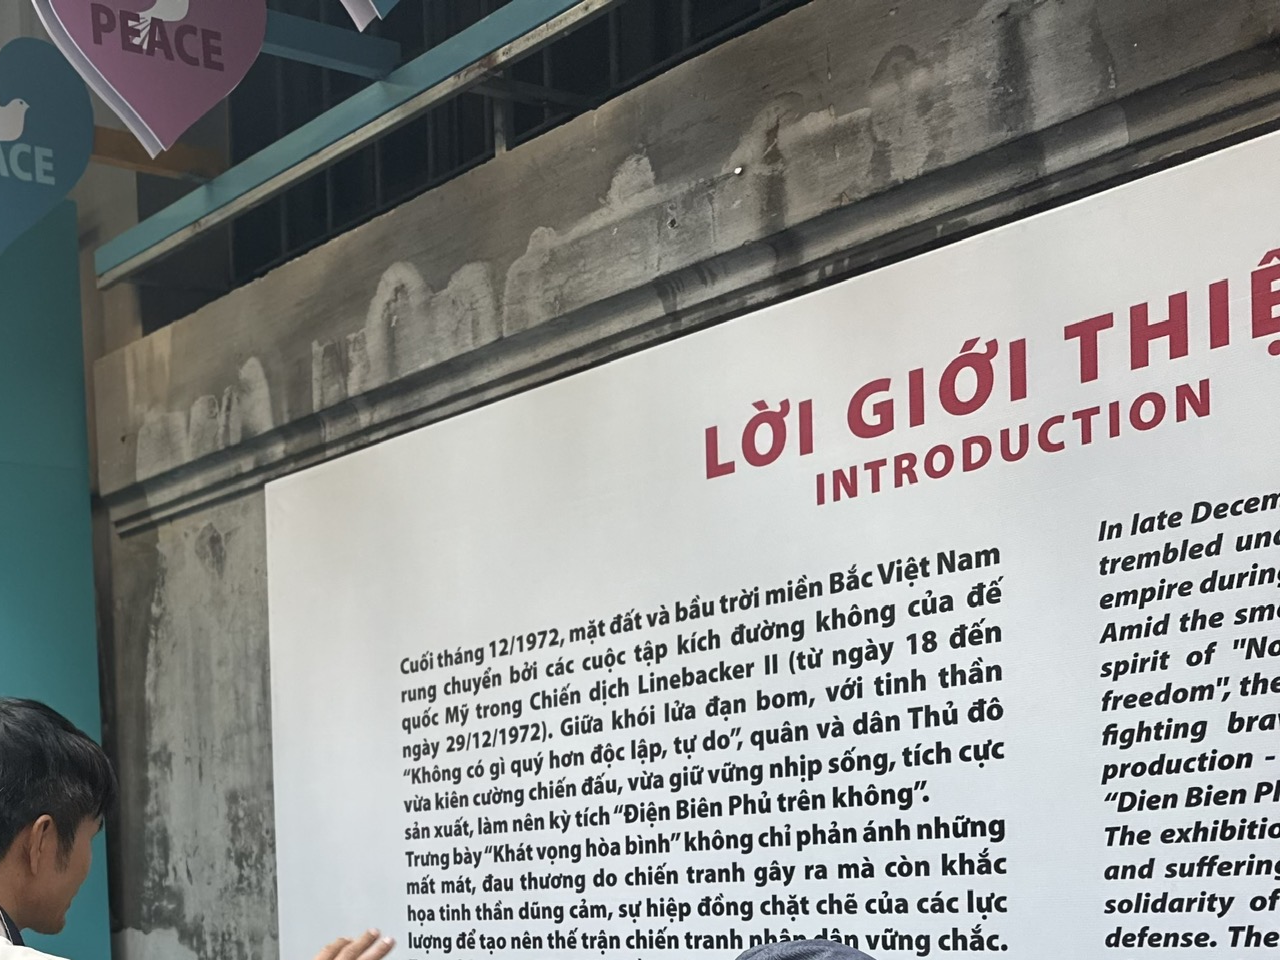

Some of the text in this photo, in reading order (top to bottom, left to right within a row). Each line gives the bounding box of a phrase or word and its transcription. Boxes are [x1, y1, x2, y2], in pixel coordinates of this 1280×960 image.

[90, 3, 225, 72] PEACE
[705, 398, 814, 479] LỜI
[846, 336, 1028, 439] GIỚI
[816, 378, 1212, 506] INTRODUCTION
[1098, 520, 1122, 541] In
[1131, 510, 1183, 536] late
[1099, 533, 1224, 576] trembled
[1100, 563, 1280, 609] empire durin
[401, 548, 1000, 674] Cuối tháng 12/1972, mặt đất và bầu trời miền Bắc Việt Nam
[1099, 604, 1280, 644] Amid the sm
[402, 576, 1003, 703] rung chuyển bởi các cuộc tập kích đường không của đế
[402, 618, 1001, 734] quốc Mỹ trong Chiến dịch Linebacker II (từ ngày 18 đến
[1100, 650, 1170, 681] spirit
[1186, 641, 1217, 666] of
[1102, 672, 1280, 711] freedom", the
[404, 697, 1003, 784] “Không có gì quý hơn độc lập, tự do”, quân và dân Thủ đô
[1102, 718, 1207, 750] fighting
[1101, 749, 1253, 785] production
[405, 780, 929, 840] sản xuất, làm nên kỳ tích “Điện Biên Phủ trên không”.
[1104, 785, 1247, 812] “Dien Bien
[405, 815, 1005, 870] Trưng bày “Khát vọng hòa bình” không chỉ phản ánh những
[1105, 825, 1151, 846] The
[1104, 858, 1155, 880] and
[1104, 888, 1280, 918] solidarity of
[1105, 925, 1279, 947] defense. The
